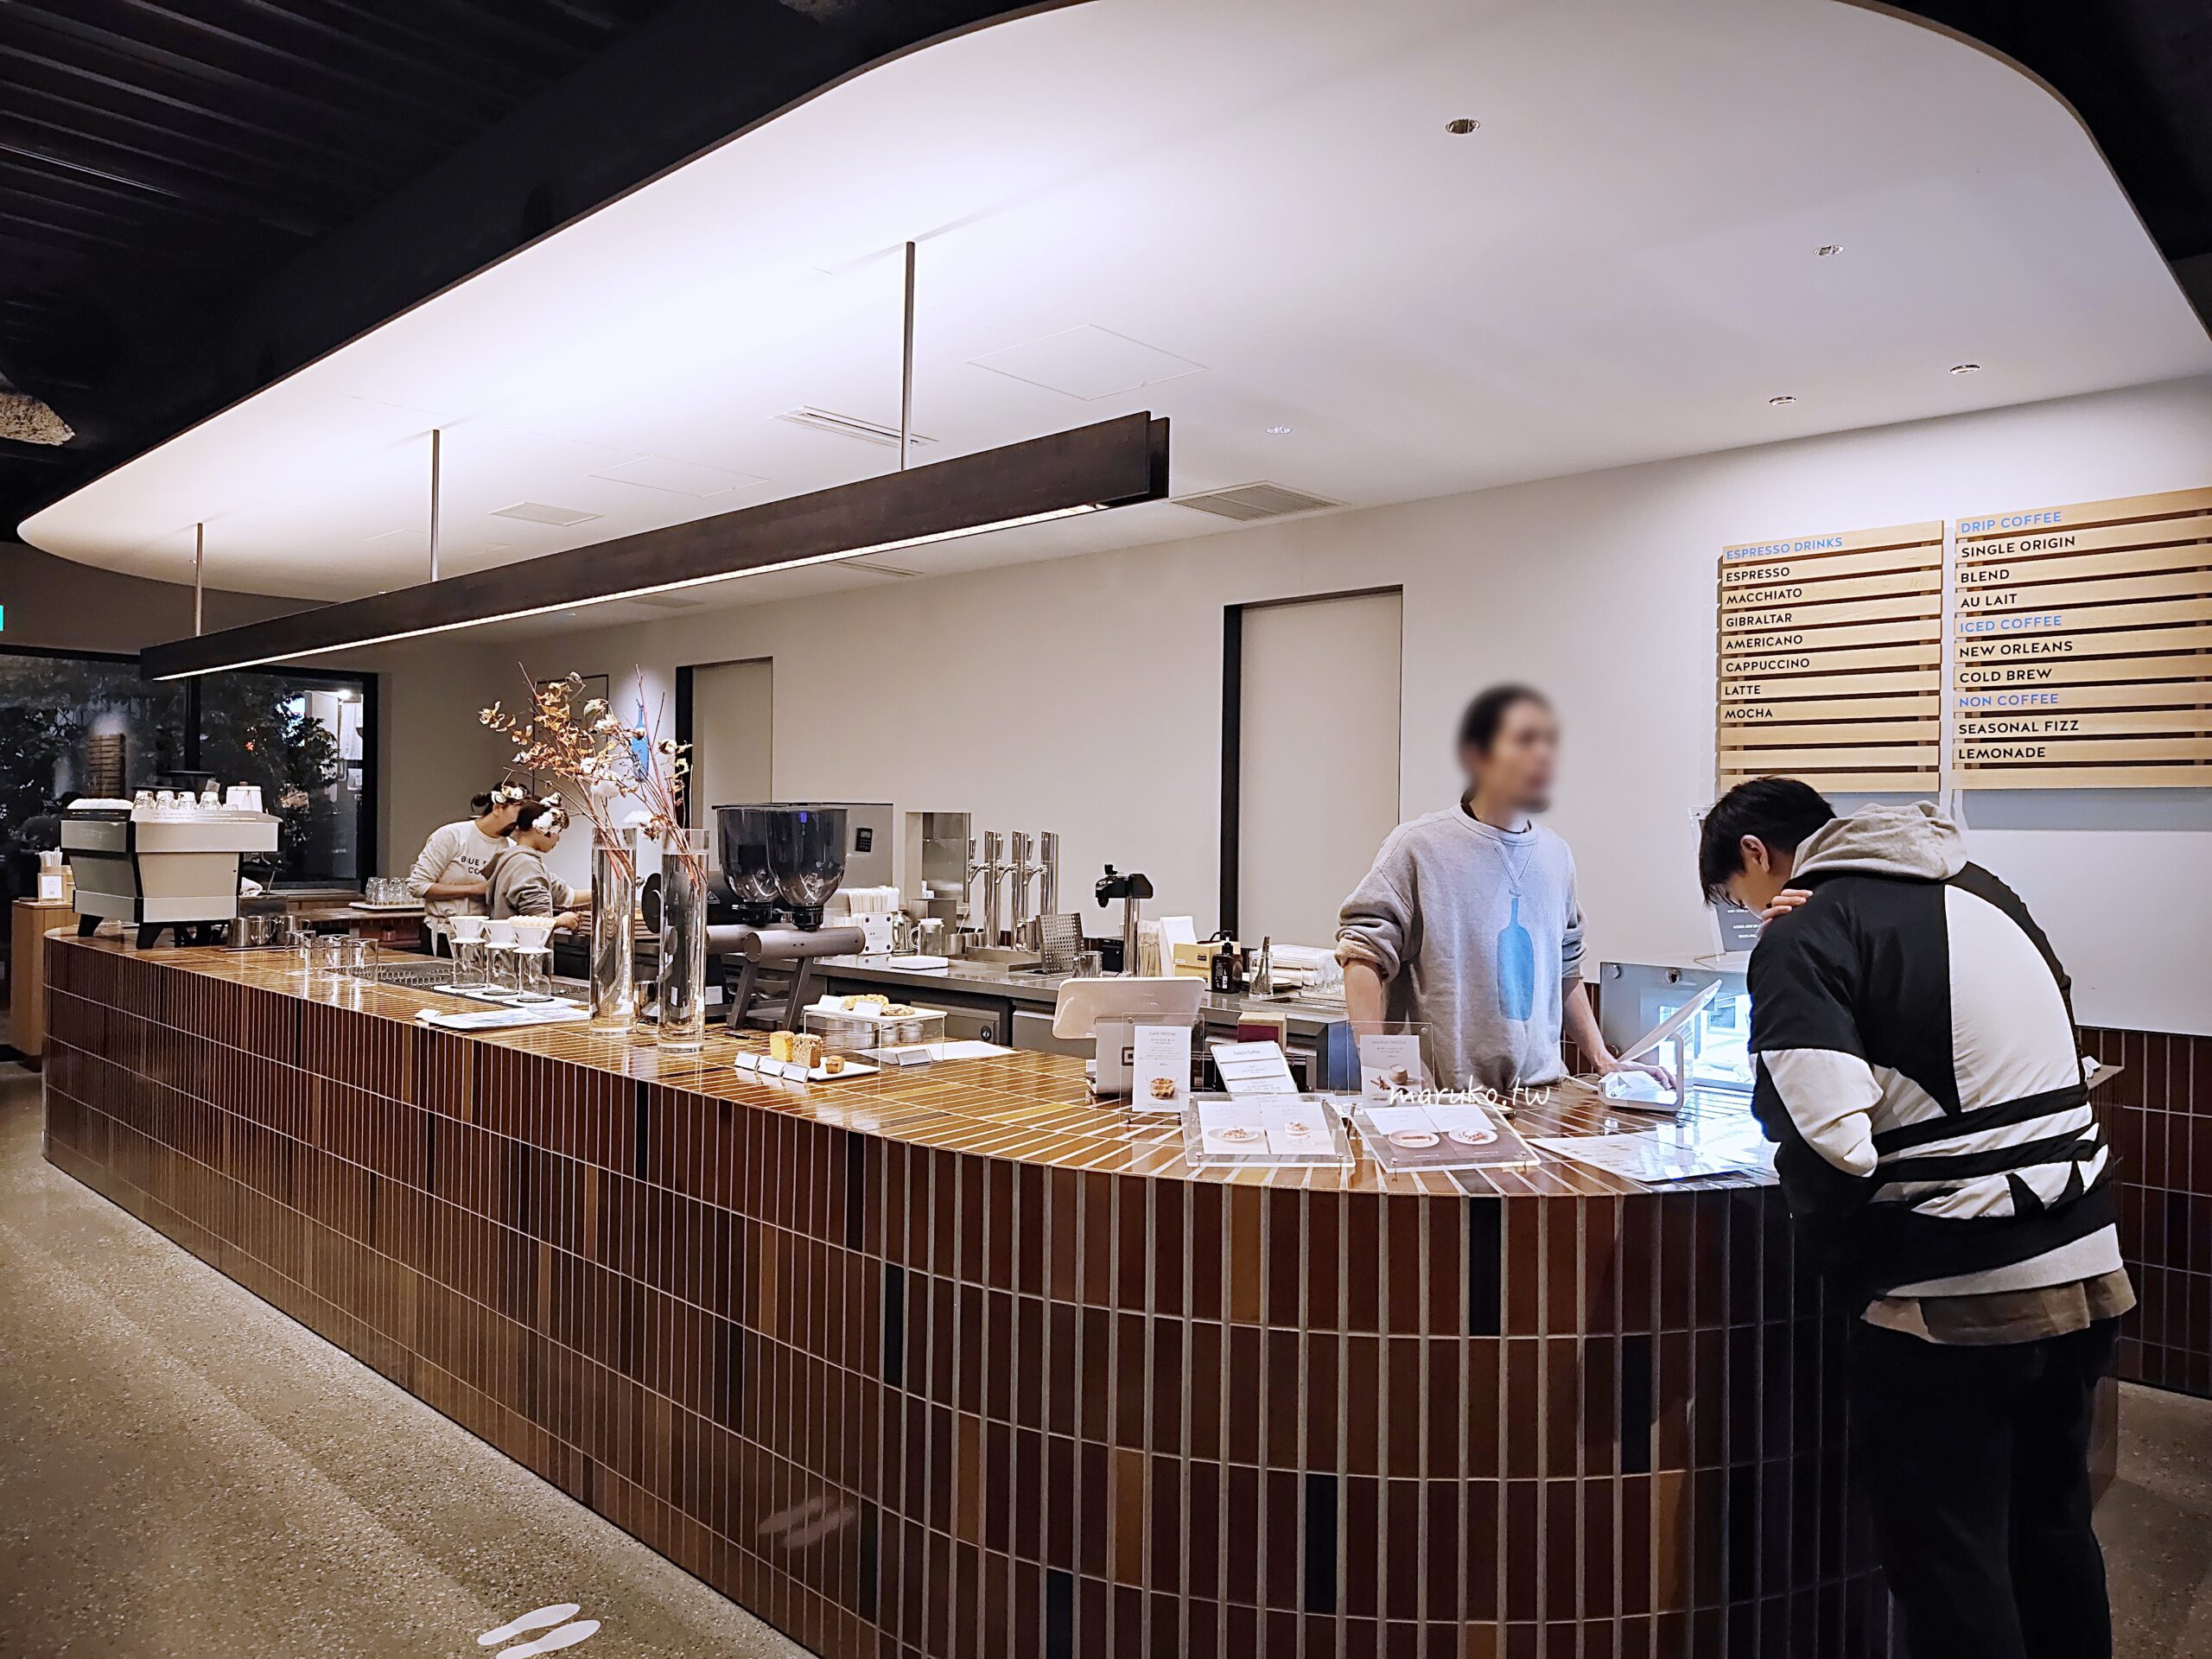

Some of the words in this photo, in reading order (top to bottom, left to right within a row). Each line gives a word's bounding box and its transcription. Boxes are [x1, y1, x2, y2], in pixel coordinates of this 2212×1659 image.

[1961, 520, 1996, 533] DRIP
[2000, 511, 2063, 529] COFFEE
[1726, 543, 1790, 560] ESPRESSO
[1794, 537, 1843, 552] DRINKS
[1961, 543, 2015, 558] SINGLE
[2019, 536, 2075, 552] ORIGIN
[1726, 567, 1790, 582] ESPRESSO
[1961, 569, 2010, 583] BLEND
[1726, 588, 1802, 605] MACCHIATO
[1961, 596, 1980, 608] AU
[1986, 594, 2018, 607] LAIT
[1726, 613, 1793, 627] GIBRALTAR
[1960, 620, 1995, 633] ICED
[2000, 614, 2063, 631] COFFEE
[1726, 634, 1803, 650] AMERICANO
[1960, 645, 1995, 658] NEW
[2000, 640, 2074, 656] ORLEANS
[1726, 658, 1810, 672] CAPPUCCINO
[1959, 671, 2001, 683] COLD
[2006, 668, 2053, 681] BREW
[1725, 685, 1761, 696] LATTE
[1959, 696, 1992, 709] NON
[1997, 693, 2059, 706] COFFEE
[1725, 708, 1773, 720] MOCHA
[1958, 721, 2039, 734] SEASONAL
[2044, 720, 2079, 732] FIZZ
[1958, 747, 2046, 760] LEMONADE
[461, 855, 480, 866] BUE
